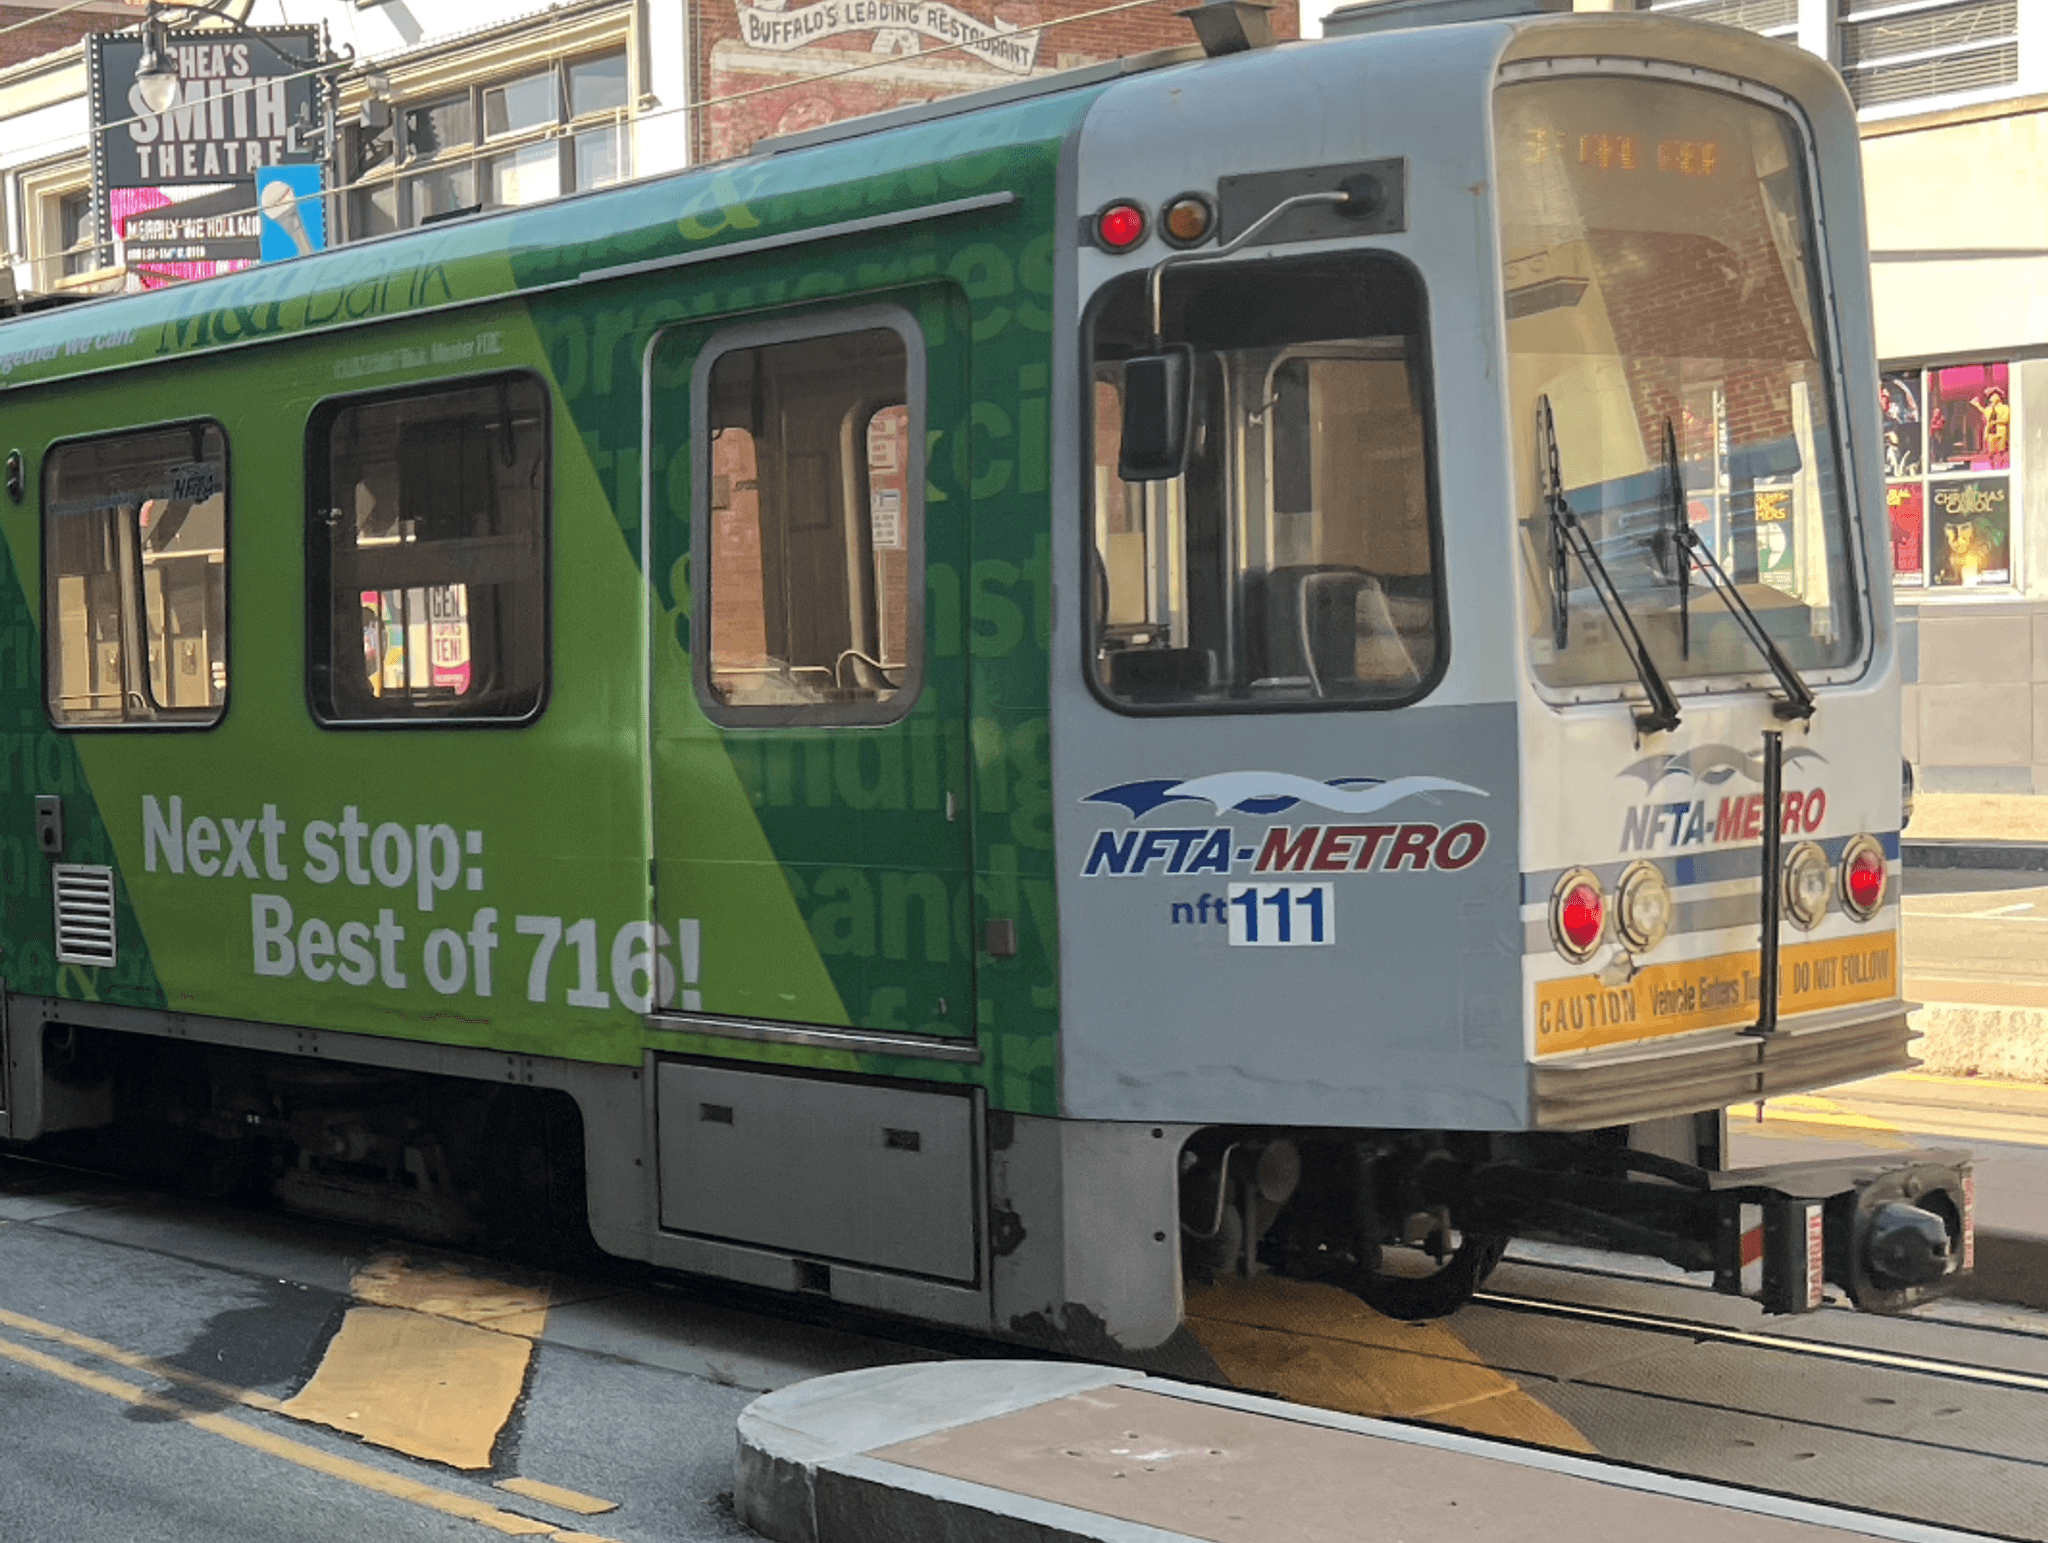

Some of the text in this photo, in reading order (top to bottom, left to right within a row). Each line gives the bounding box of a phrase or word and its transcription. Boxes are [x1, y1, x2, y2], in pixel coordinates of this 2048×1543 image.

[751, 6, 838, 43] BUFFALO'S
[845, 1, 919, 24] LEADING
[128, 76, 287, 143] SMITH
[136, 139, 283, 178] THEATRE
[142, 795, 287, 881] Next
[303, 804, 483, 912] stop:
[1081, 822, 1488, 878] NFTA-METRO
[1619, 788, 1827, 853] NFTA-MERO
[251, 894, 406, 990] Best
[423, 907, 498, 997] of
[515, 915, 701, 1014] 716!
[1540, 986, 1636, 1034] CAUTION
[1793, 960, 1809, 994] DO
[1813, 956, 1839, 990] NOT
[1841, 949, 1890, 986] FOLLOW
